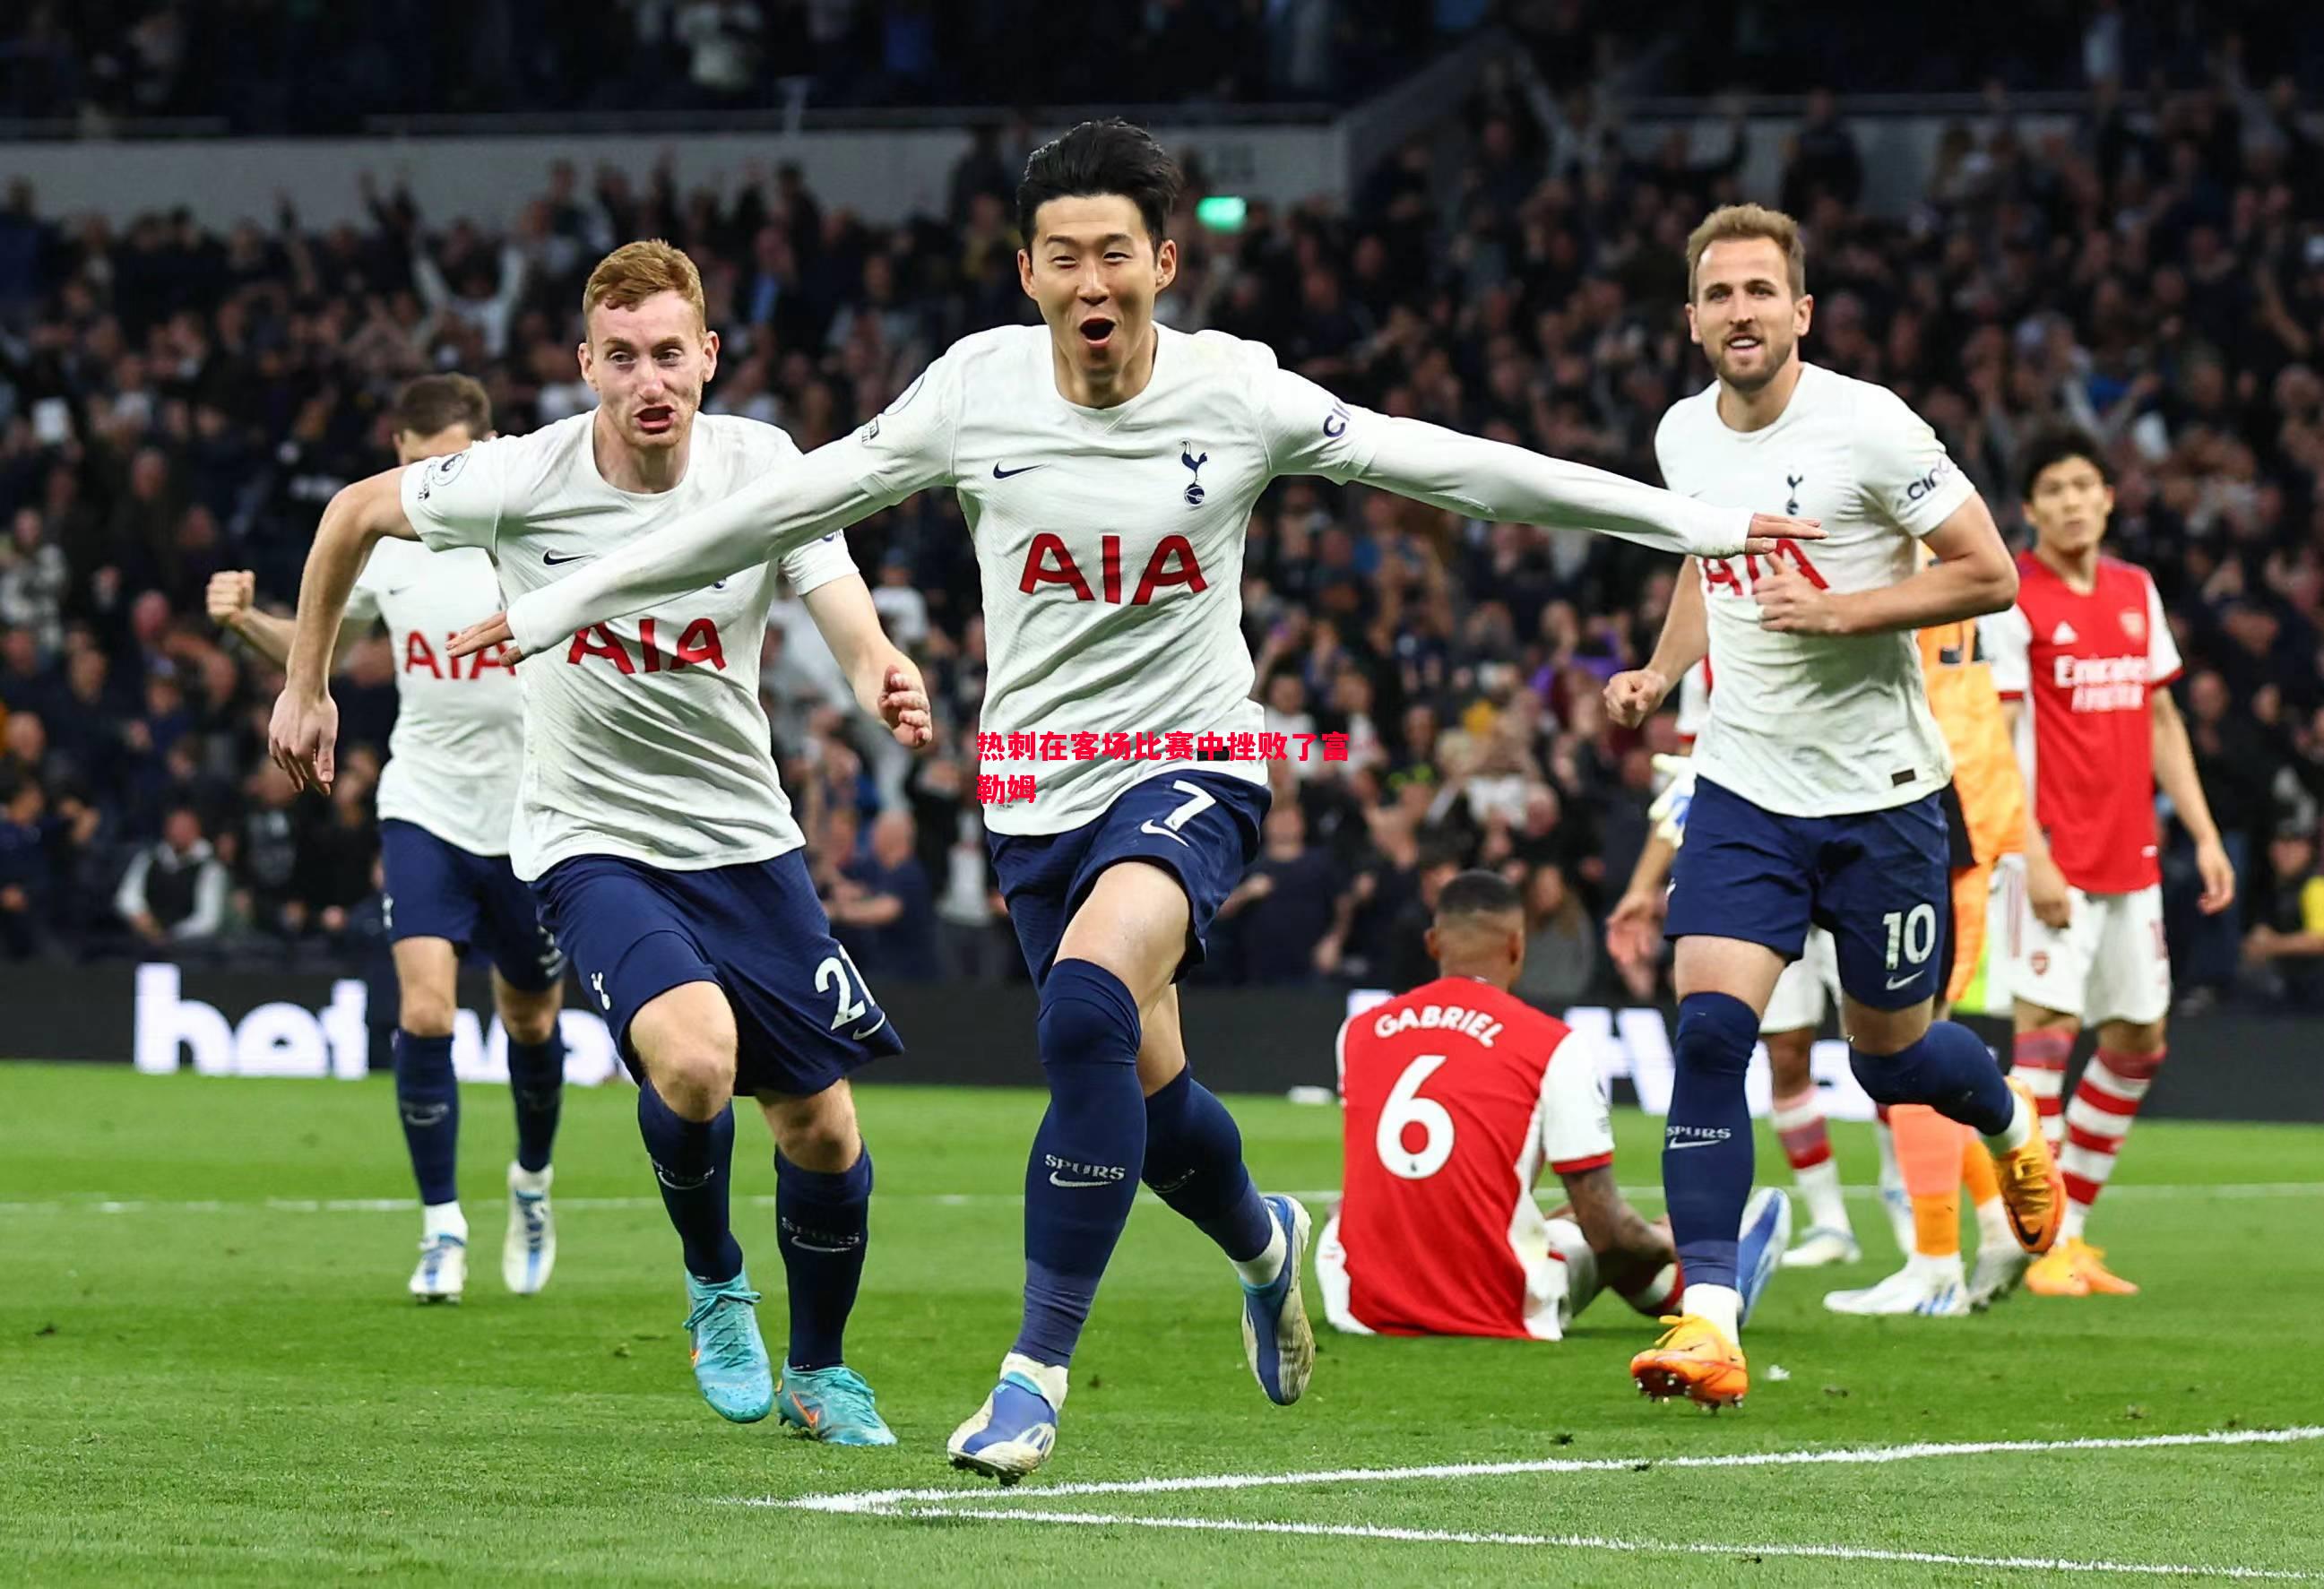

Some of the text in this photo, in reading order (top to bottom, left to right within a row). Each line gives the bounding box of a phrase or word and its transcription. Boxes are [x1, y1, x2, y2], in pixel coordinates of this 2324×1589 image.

[1018, 532, 1209, 606] AIA
[566, 617, 727, 675] AIA
[1163, 780, 1216, 832] 7
[1883, 902, 1936, 971] 10
[1374, 1005, 1505, 1049] GABRIEL
[1376, 1054, 1456, 1180] 6
[1667, 1125, 1732, 1140] SPURS
[1044, 1153, 1127, 1181] SPURS
